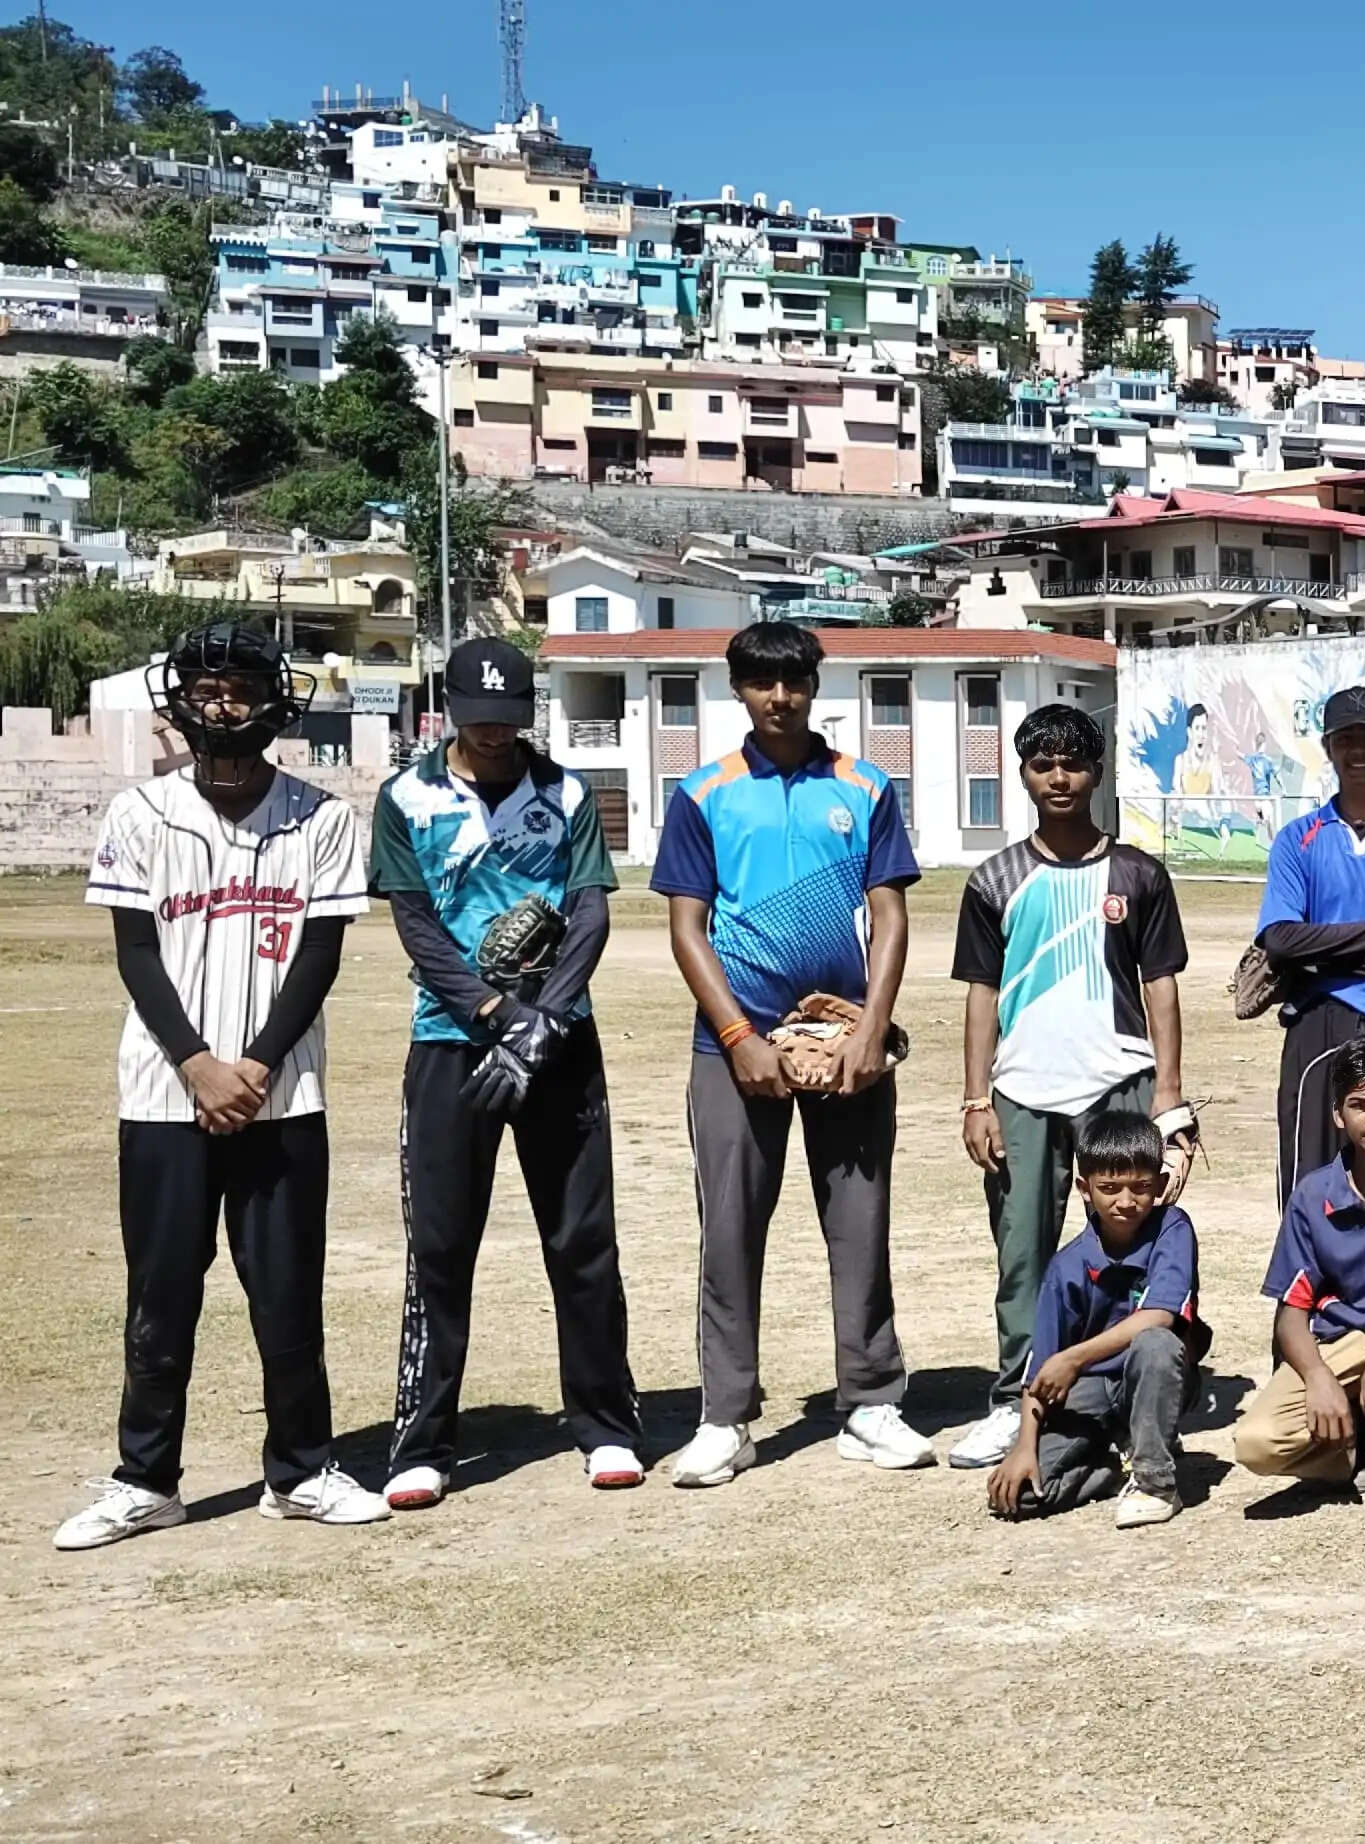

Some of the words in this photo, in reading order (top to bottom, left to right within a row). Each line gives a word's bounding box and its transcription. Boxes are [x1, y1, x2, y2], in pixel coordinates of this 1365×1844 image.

[481, 661, 505, 690] LA
[362, 696, 395, 704] DUKAN
[257, 916, 292, 962] 31
